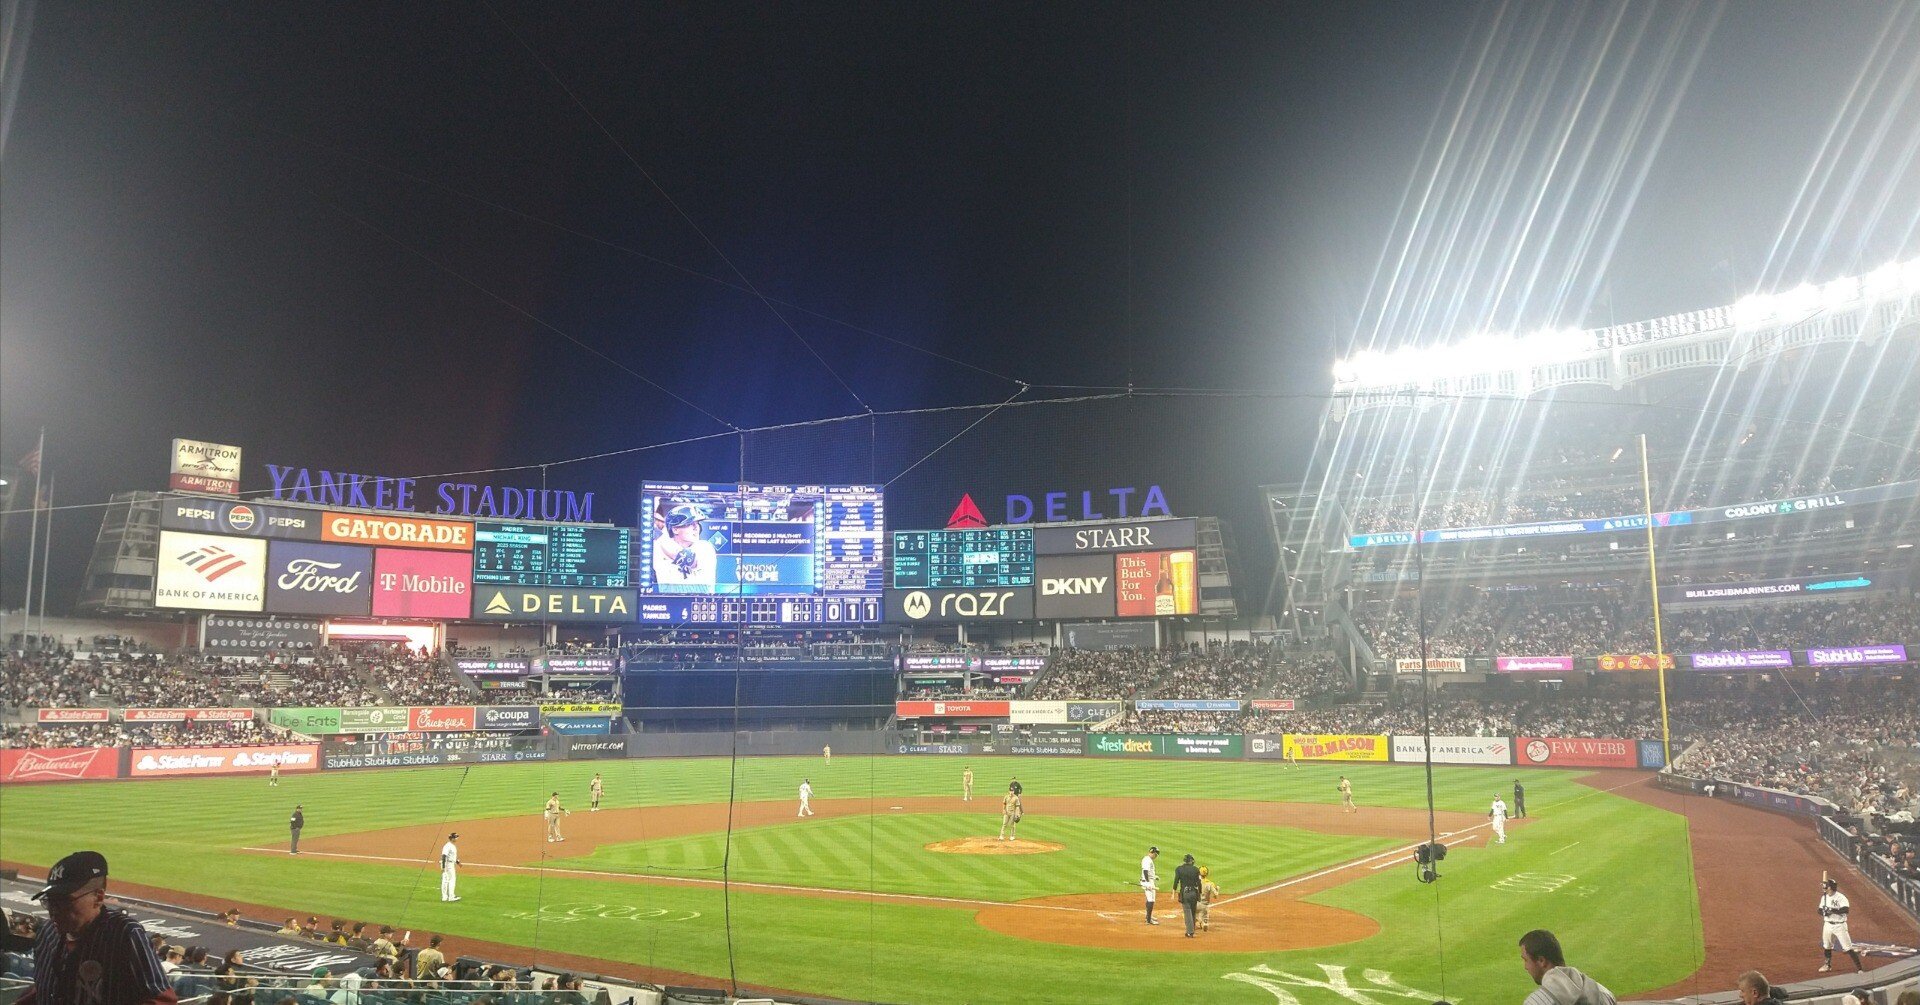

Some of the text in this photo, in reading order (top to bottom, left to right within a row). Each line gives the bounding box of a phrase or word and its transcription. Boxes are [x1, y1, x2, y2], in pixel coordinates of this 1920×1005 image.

[179, 445, 237, 459] ARMITRON
[180, 477, 233, 489] ARMITRON
[266, 464, 595, 523] YANKEE STADIUM
[1006, 485, 1172, 524] DELTA
[1725, 495, 1846, 519] COLONY GRILL
[177, 507, 215, 520] PEPSI
[230, 514, 253, 523] PEPSI
[268, 516, 305, 530] PEPSI
[1612, 517, 1648, 529] DELTA
[331, 518, 467, 545] GATORADE
[1075, 527, 1153, 549] STARR
[1376, 534, 1408, 544] DELTA
[899, 541, 905, 549] 0
[918, 541, 924, 549] 0
[1120, 557, 1146, 567] This
[277, 558, 362, 594] Ford
[1120, 567, 1152, 579] Bud's
[380, 573, 466, 595] T Mobile
[606, 578, 625, 587] 8:22
[1041, 577, 1108, 596] DKNY
[1121, 579, 1140, 590] For
[158, 588, 259, 602] BANK OF AMERICA
[1120, 590, 1146, 601] You.
[1686, 583, 1801, 599] BUILDSUBMARINES.COM
[523, 593, 627, 614] DELTA
[941, 592, 1014, 616] razr
[829, 604, 840, 620] 0
[849, 604, 856, 620] 1
[867, 604, 874, 620] 1
[1019, 658, 1044, 666] GRILL
[1695, 653, 1746, 667] StubHub
[1813, 649, 1863, 663] StubHub
[496, 661, 526, 669] GRILL
[1400, 658, 1461, 669] Parts uthority
[59, 711, 102, 720] State Farm
[147, 711, 186, 719] State Farm
[208, 710, 244, 719] State Farm
[499, 710, 529, 720] coupa
[1087, 707, 1117, 717] CLEAR
[307, 715, 337, 727] Eats
[571, 742, 624, 751] NITTOTIRE.COM
[1101, 736, 1153, 752] freshdirect
[1177, 737, 1229, 747] Make every meal
[1011, 746, 1035, 754] StubHub
[1059, 747, 1082, 755] StubHub
[1190, 745, 1208, 753] home
[1396, 745, 1421, 754] BANK
[1438, 745, 1484, 755] AMERICA
[1551, 742, 1626, 755] F.W. WEBB
[158, 754, 225, 768] State Farm
[245, 752, 312, 766] State Farm
[328, 755, 439, 768] StubHub StubHub StubHub
[482, 753, 507, 761] STARR
[17, 757, 89, 772] Budweiser
